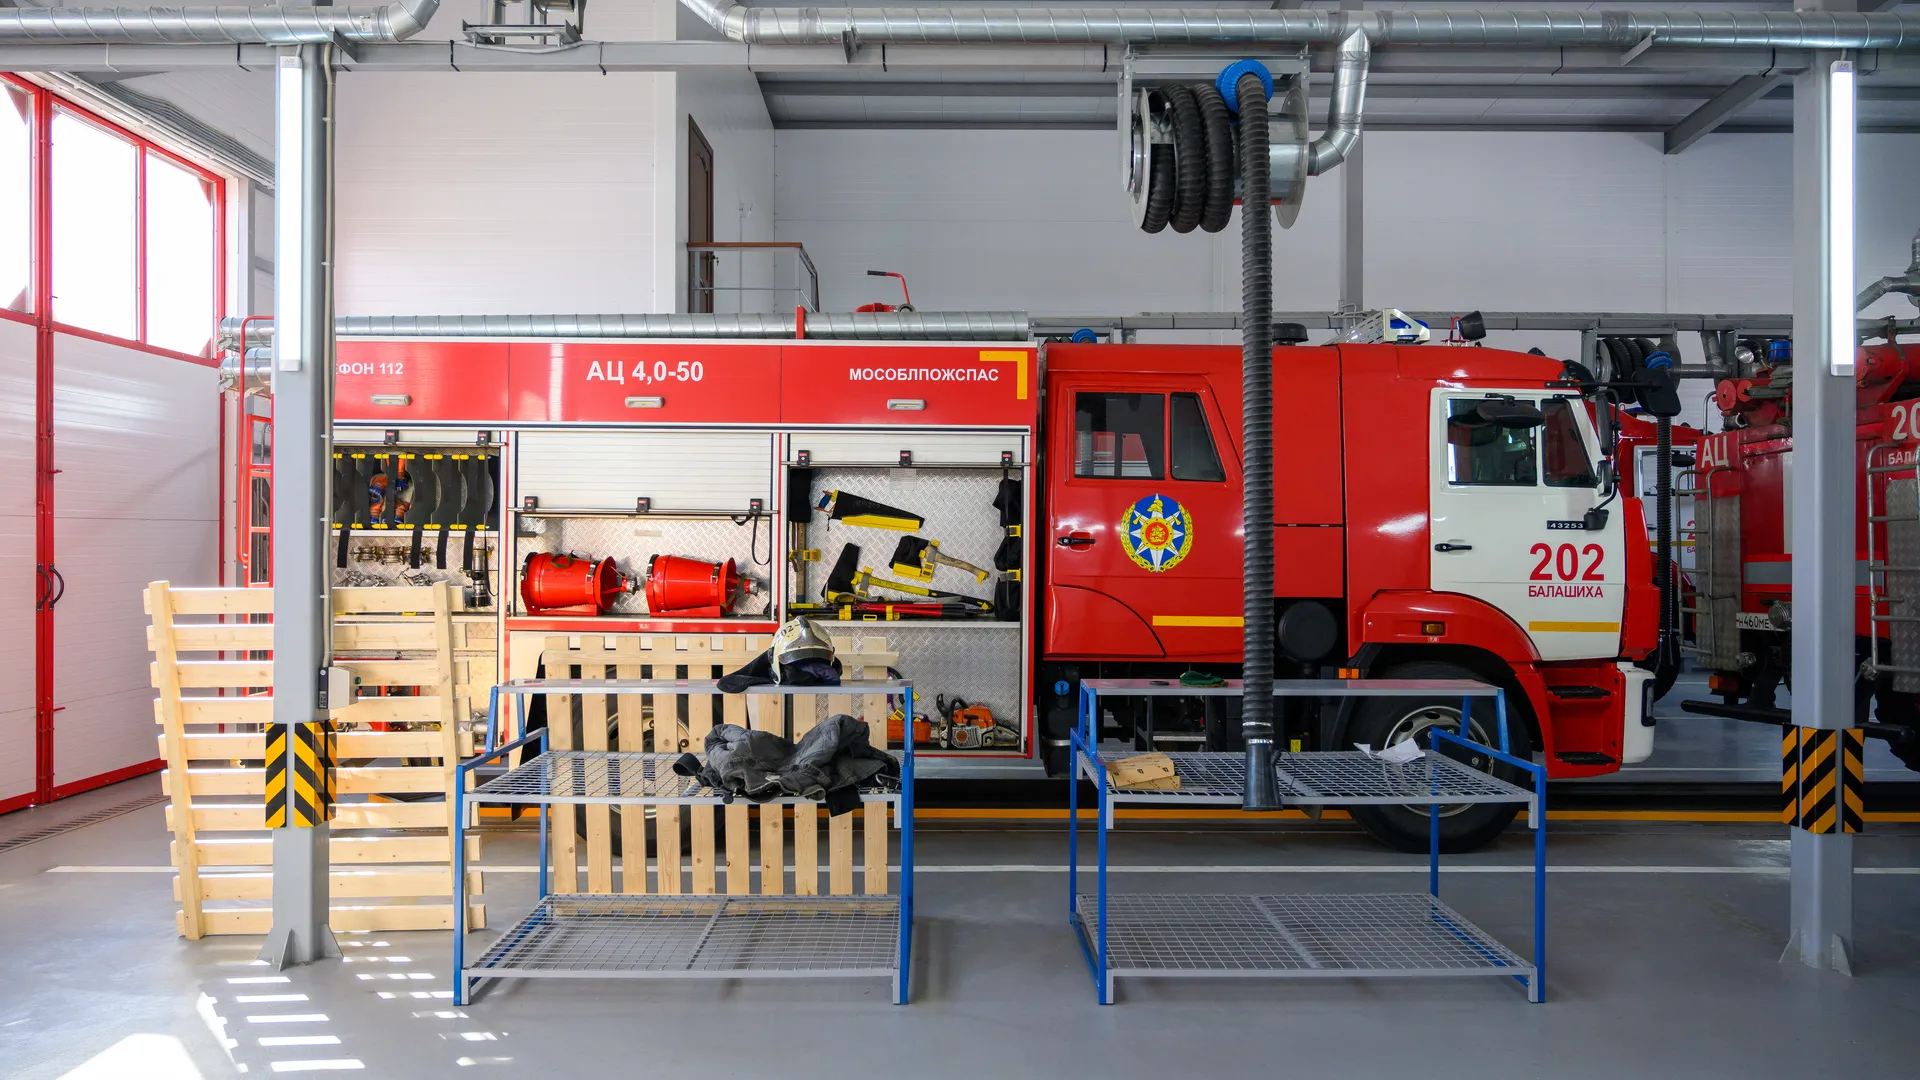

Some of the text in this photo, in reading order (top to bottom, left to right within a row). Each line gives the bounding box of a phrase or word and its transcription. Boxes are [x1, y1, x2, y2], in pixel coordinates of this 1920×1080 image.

[335, 362, 404, 375] ФОН 112
[586, 360, 704, 385] АЦ 4,0-50
[849, 368, 999, 381] МОСОБЛПОЖСПАС
[1701, 436, 1729, 468] АЦ
[1529, 542, 1605, 581] 202
[1528, 585, 1604, 598] БАЛАШИХА
